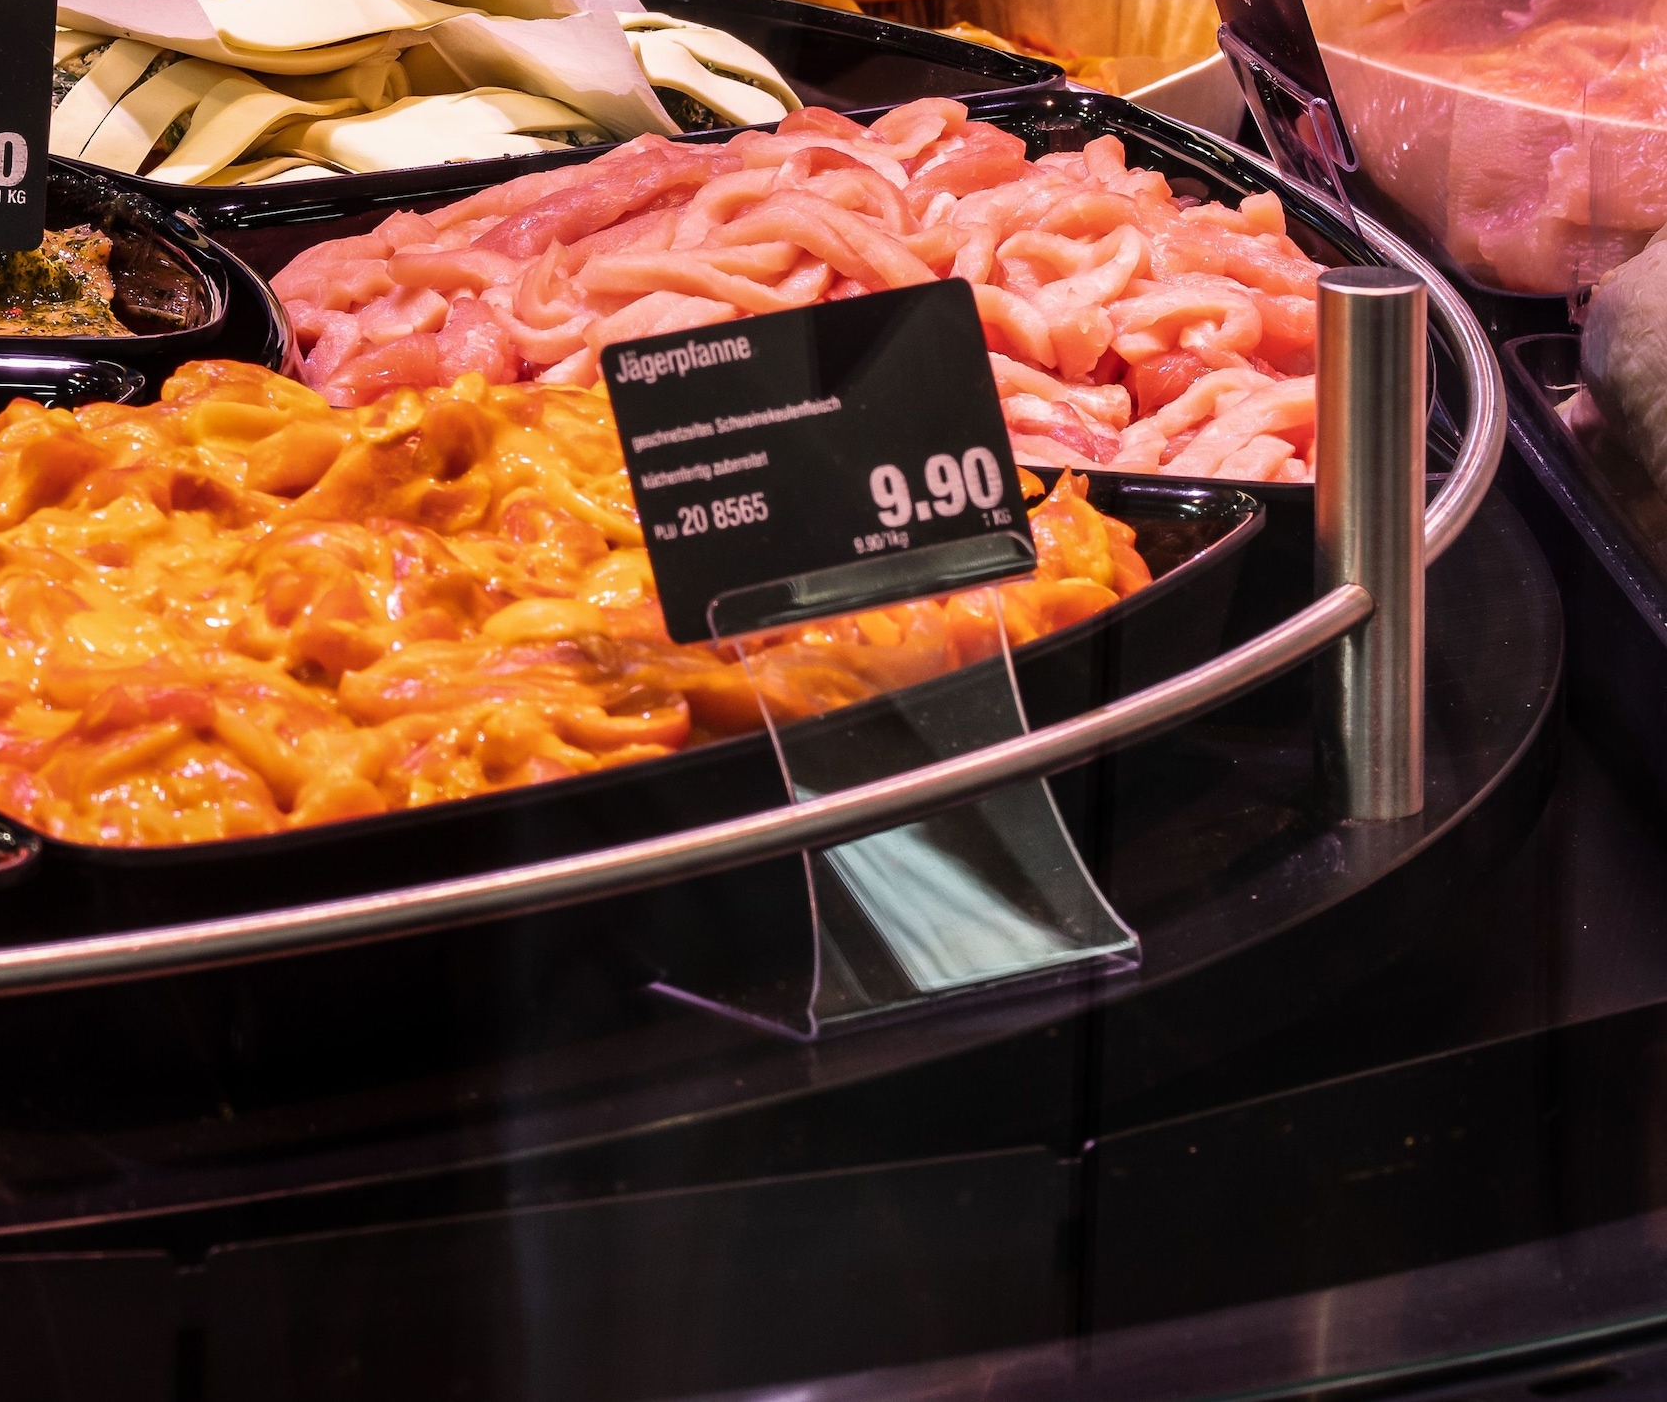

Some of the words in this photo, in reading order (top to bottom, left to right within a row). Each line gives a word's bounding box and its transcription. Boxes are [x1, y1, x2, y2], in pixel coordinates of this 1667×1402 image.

[7, 189, 26, 204] KG
[616, 336, 752, 384] Jägerpfanne
[713, 452, 768, 476] zubereitet
[870, 447, 1003, 527] 9.90
[654, 524, 678, 540] PLU
[678, 505, 708, 536] 20
[711, 492, 768, 529] 8565
[853, 530, 909, 554] 9.90/1kg
